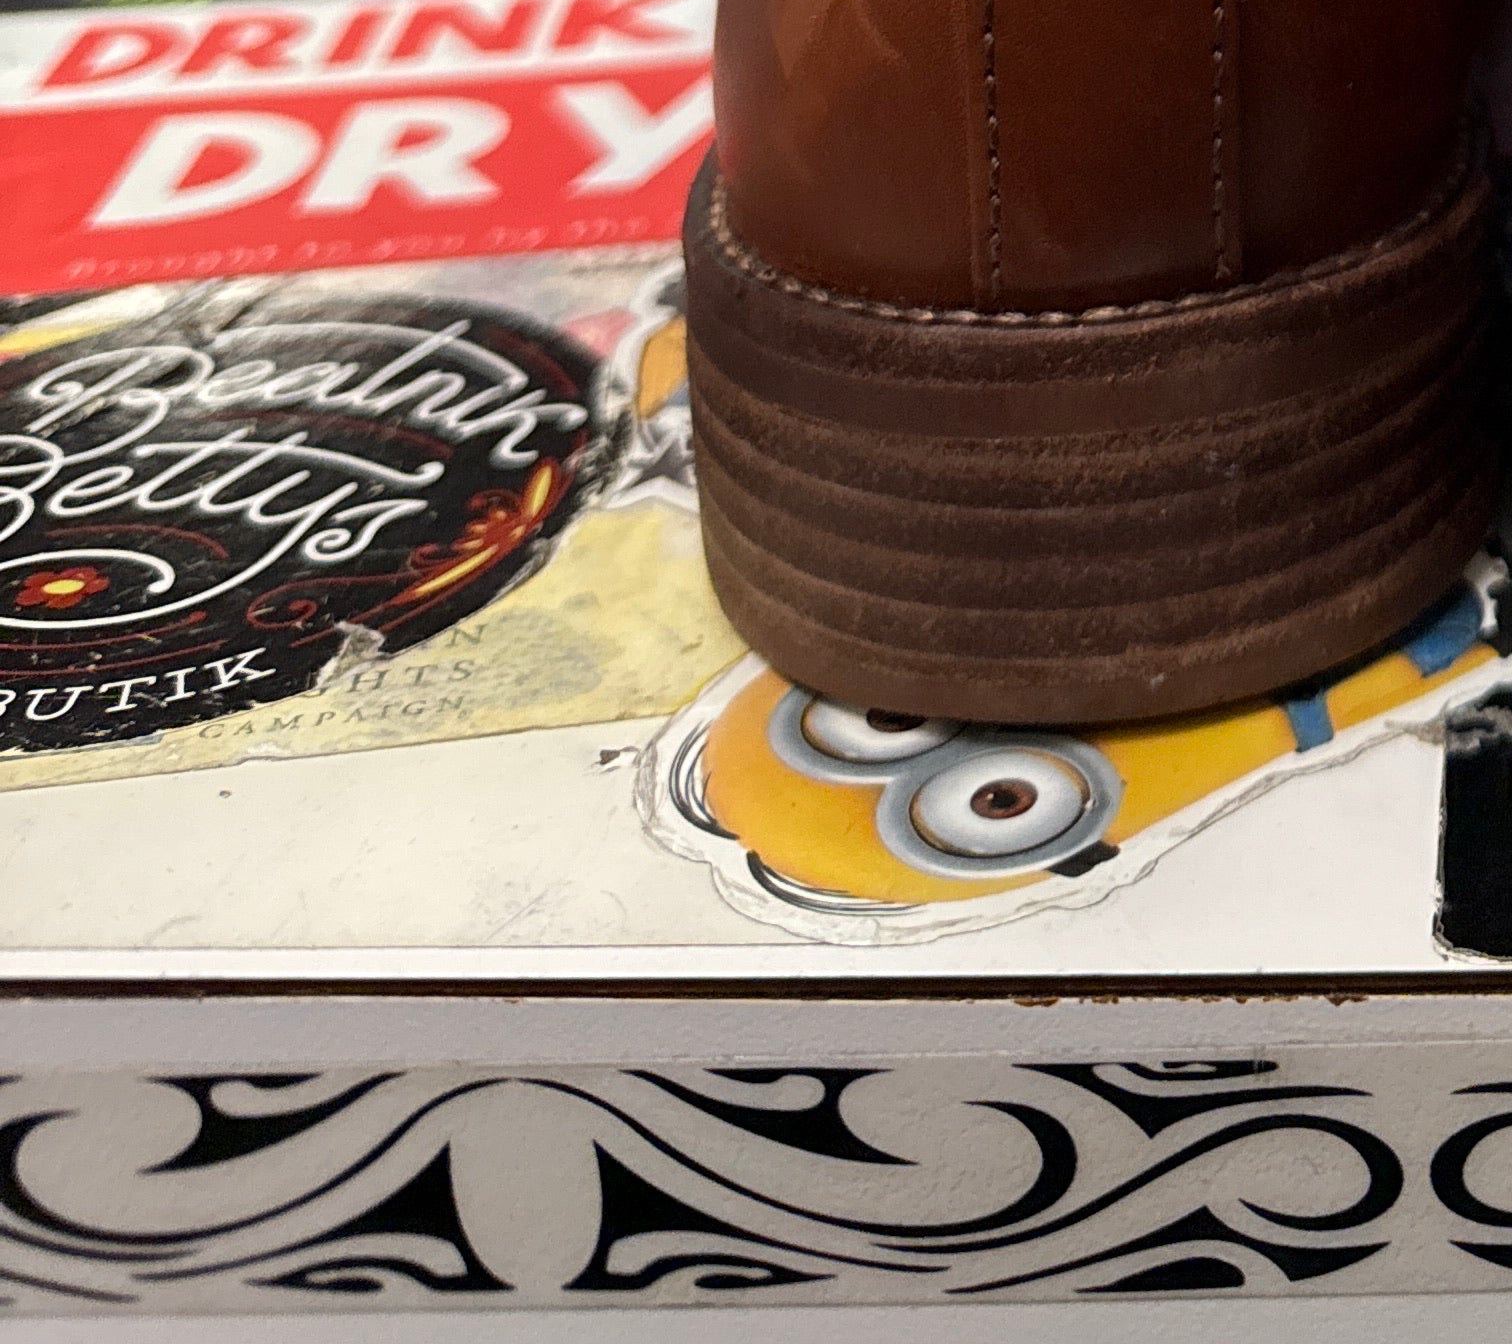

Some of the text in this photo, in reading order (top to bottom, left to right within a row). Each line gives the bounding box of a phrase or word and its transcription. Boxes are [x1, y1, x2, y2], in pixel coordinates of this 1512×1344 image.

[88, 80, 714, 227] DRY
[302, 660, 476, 698] HTS
[198, 696, 467, 740] CAMPAIGN
